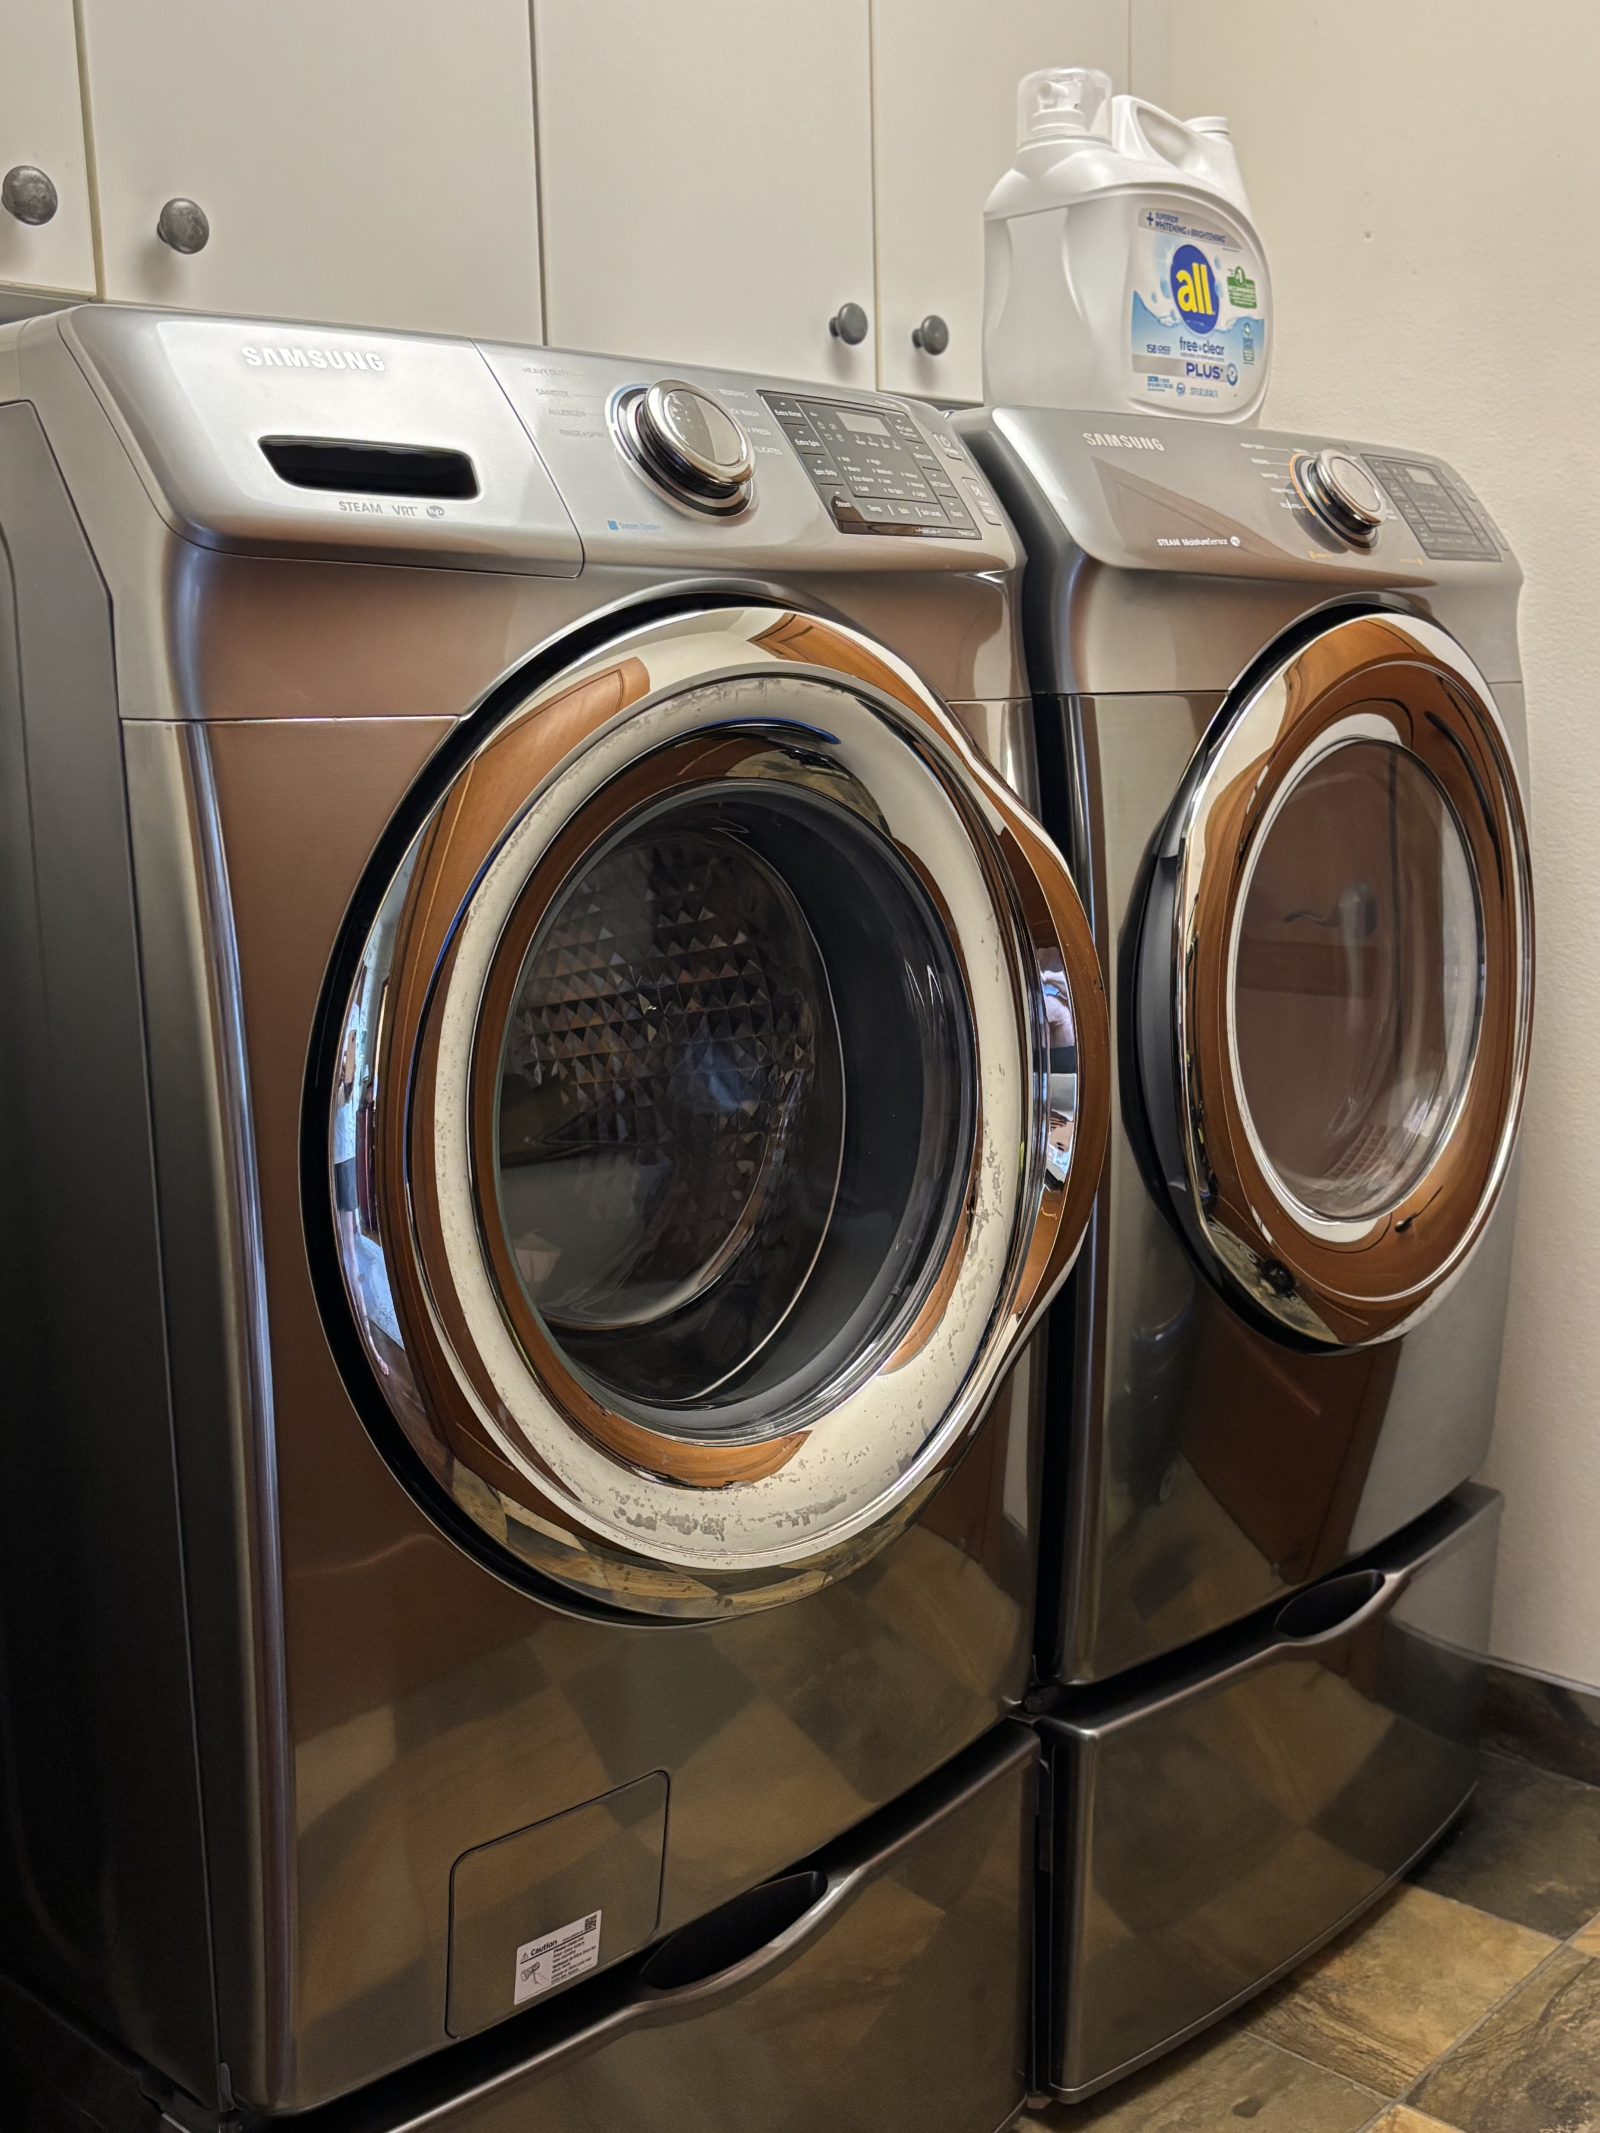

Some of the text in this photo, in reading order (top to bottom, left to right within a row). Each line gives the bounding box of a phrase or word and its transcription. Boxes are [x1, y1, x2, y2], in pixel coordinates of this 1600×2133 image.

[1155, 212, 1179, 223] SUPERIOR
[1155, 220, 1187, 235] WHITENING
[1190, 228, 1226, 244] BRIGHTENING
[1176, 262, 1214, 316] all
[1146, 344, 1157, 354] 158
[1180, 337, 1198, 352] free
[1202, 340, 1225, 356] clear
[240, 346, 386, 372] SAMSUNG
[1082, 432, 1164, 451] SAMSUNG
[754, 446, 782, 455] ELICATES
[825, 469, 837, 477] Only
[338, 501, 383, 514] STEAM
[1156, 538, 1181, 546] STEAM
[530, 1940, 558, 1956] Caution
